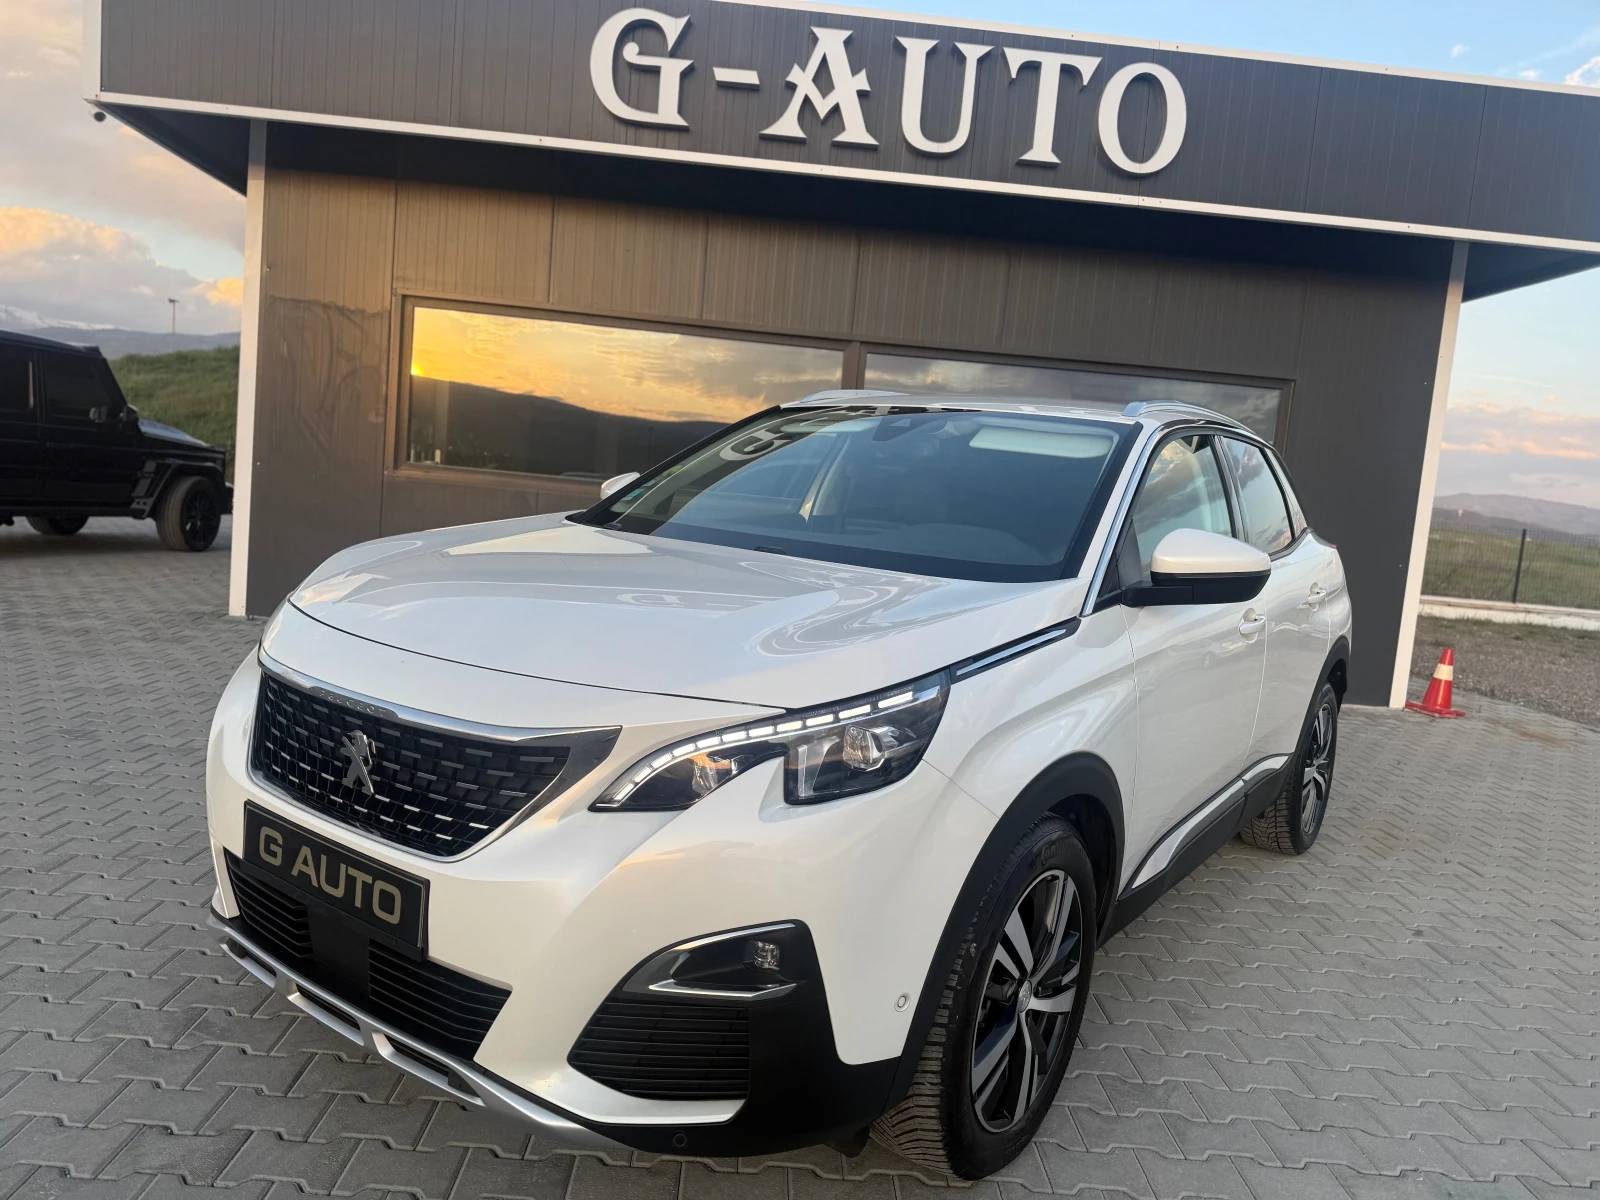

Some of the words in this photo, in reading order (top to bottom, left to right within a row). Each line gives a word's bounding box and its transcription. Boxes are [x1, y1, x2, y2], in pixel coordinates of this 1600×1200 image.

[589, 7, 1188, 176] G-AUTO
[259, 826, 283, 867] G
[290, 845, 402, 925] AUTO
